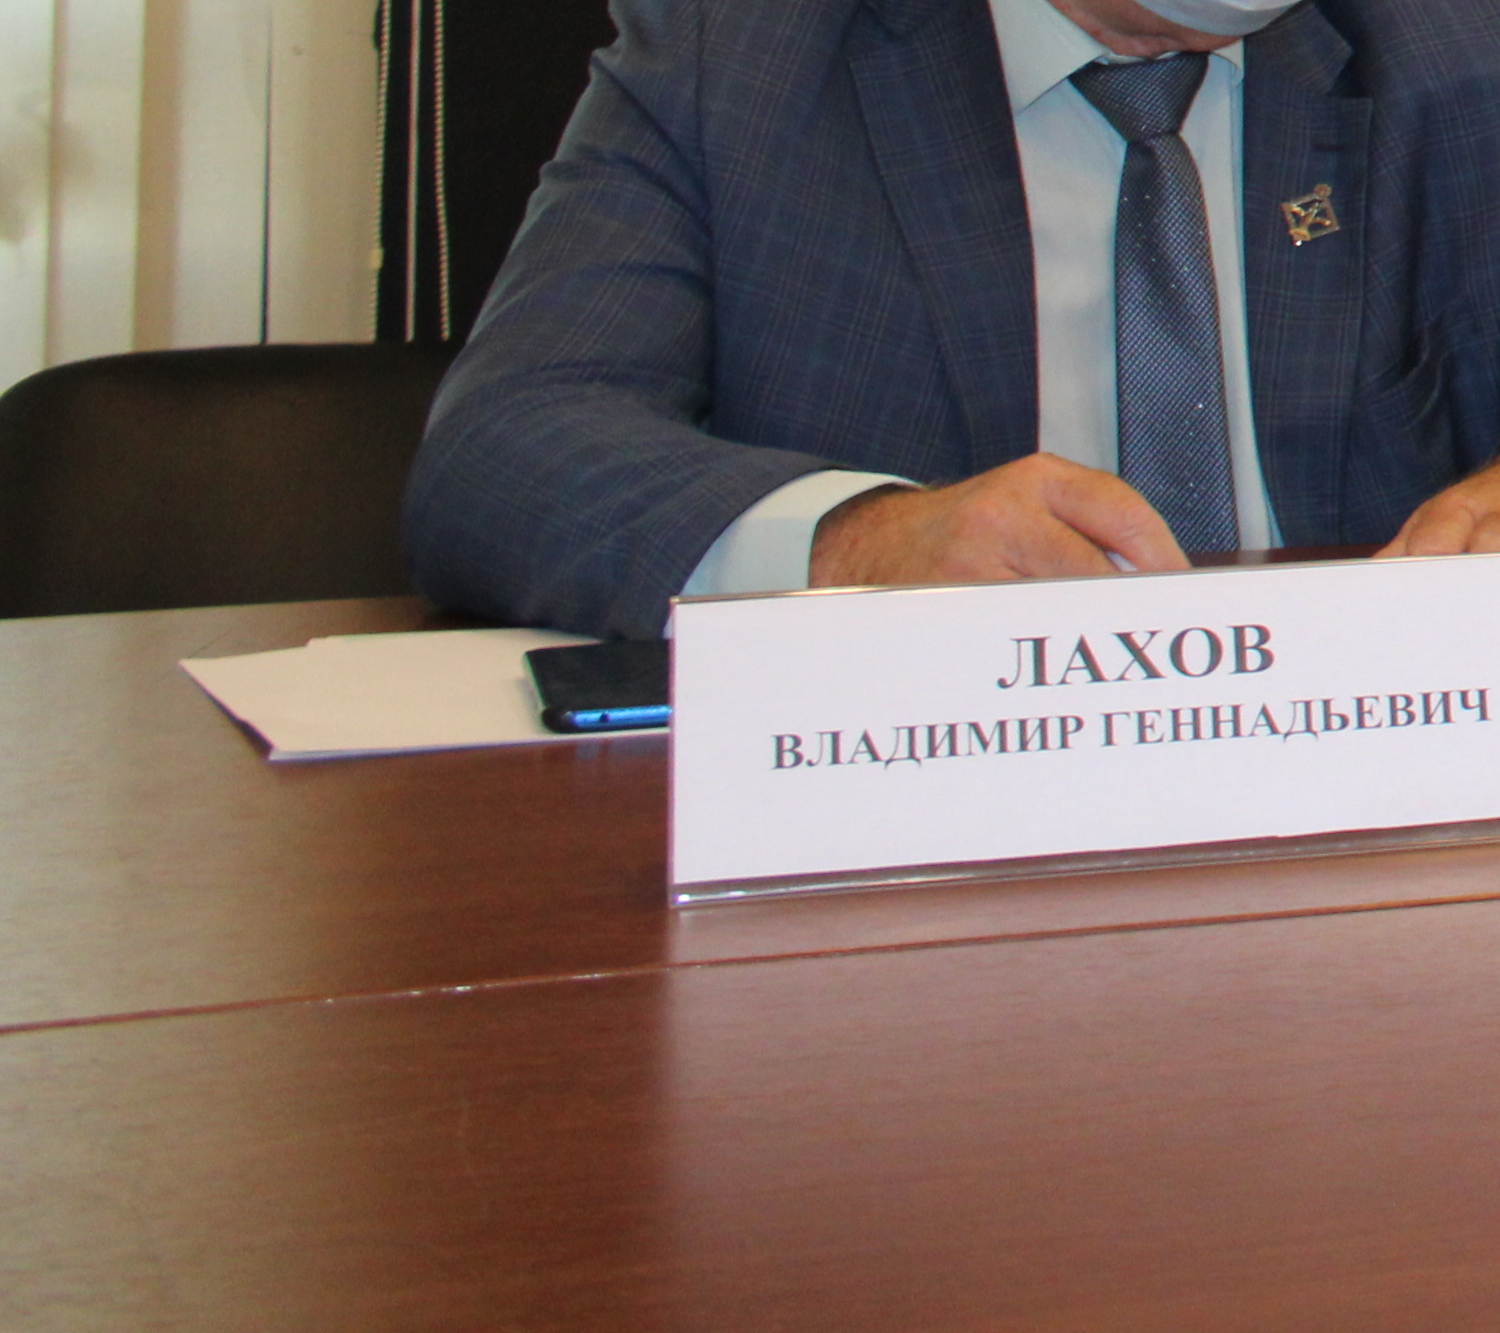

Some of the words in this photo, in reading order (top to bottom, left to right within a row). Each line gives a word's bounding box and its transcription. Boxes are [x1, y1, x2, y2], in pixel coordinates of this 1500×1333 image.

[997, 623, 1275, 691] ЛАХОВ
[772, 715, 1084, 770] ВЛАДИМИР
[1100, 687, 1494, 748] ГЕННАДЬЕВИЧ
